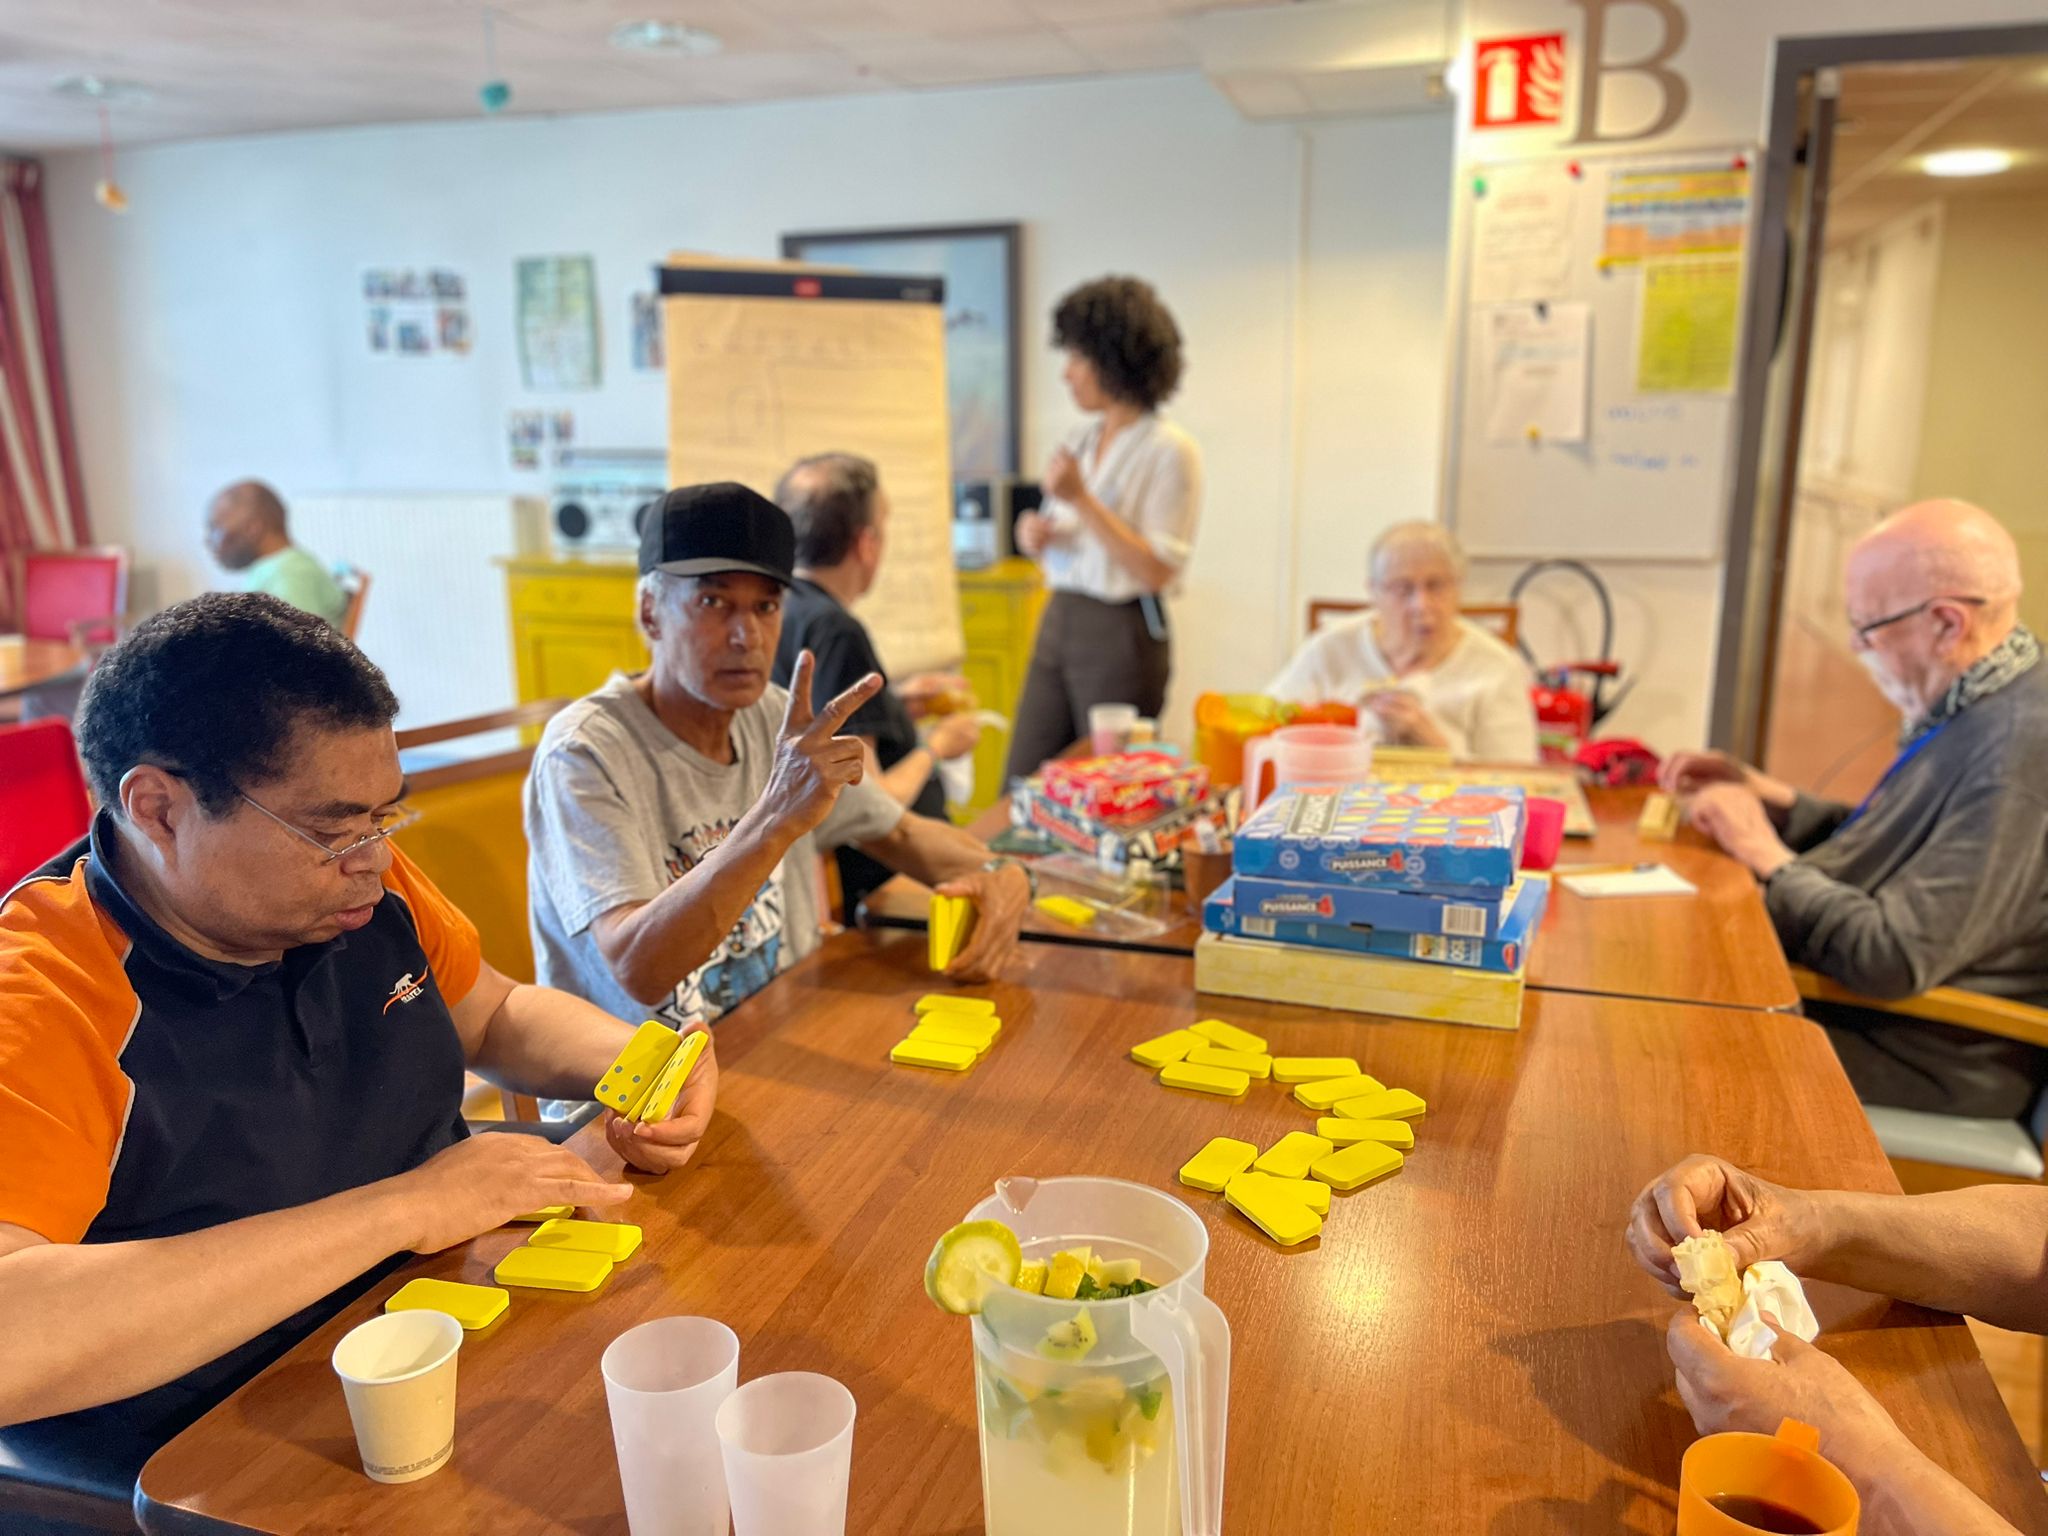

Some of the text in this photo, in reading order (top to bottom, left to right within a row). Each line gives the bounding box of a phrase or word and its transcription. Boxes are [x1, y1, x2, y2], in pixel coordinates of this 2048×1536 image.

[1558, 0, 1690, 145] B
[1331, 858, 1388, 872] PUISSANCE
[1387, 850, 1404, 872] 4
[1262, 901, 1317, 914] PUISSANCE
[1317, 895, 1333, 915] 4
